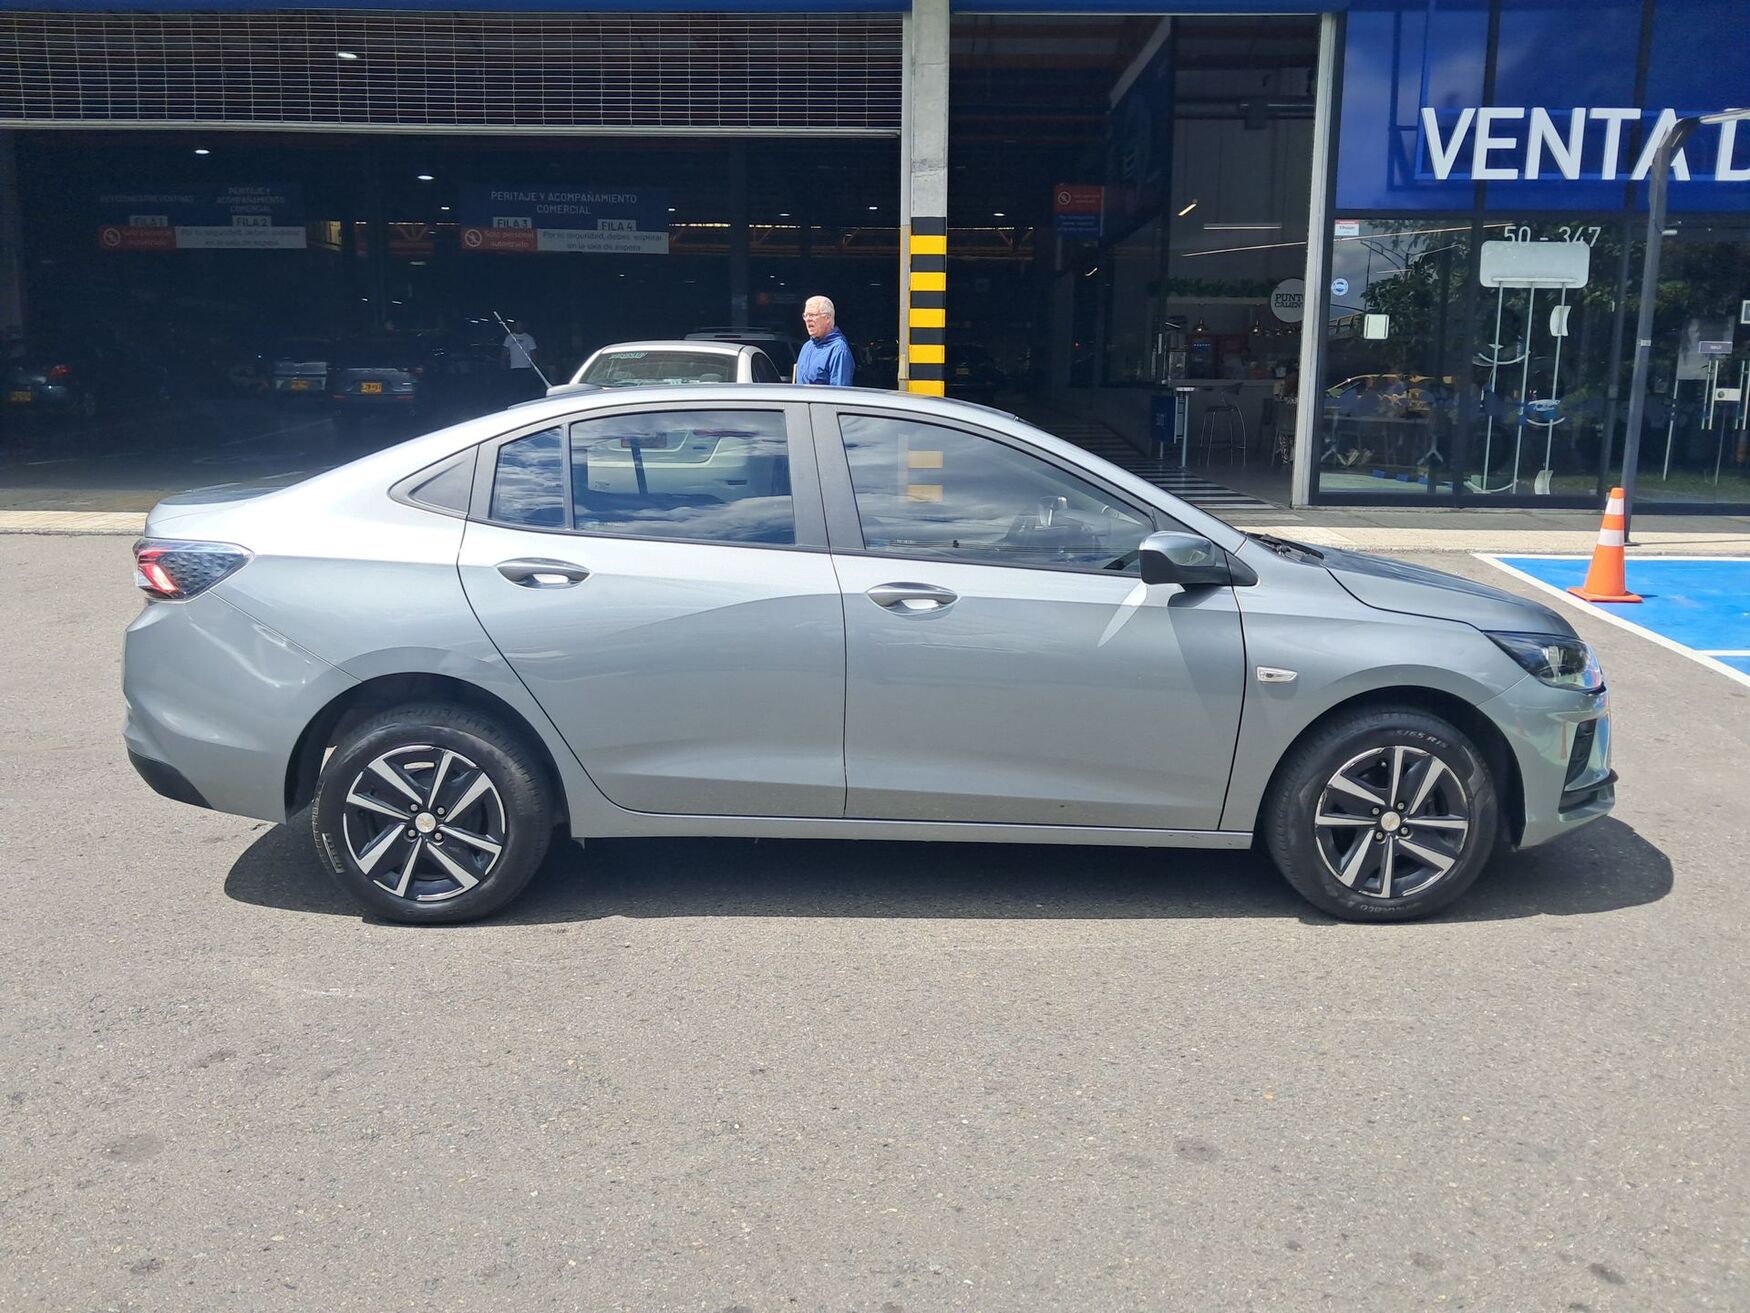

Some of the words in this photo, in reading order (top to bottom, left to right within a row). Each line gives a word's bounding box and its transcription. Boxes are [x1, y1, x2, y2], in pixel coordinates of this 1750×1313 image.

[1421, 107, 1690, 181] VENTA
[490, 190, 537, 202] PERITAJE
[539, 191, 545, 202] Y
[547, 190, 637, 204] ACOMPAÑAMIENTO
[536, 204, 592, 214] COMERCIAL
[236, 217, 259, 227] FILA
[261, 217, 268, 227] 2
[497, 218, 520, 229] FILA
[522, 219, 529, 229] 3
[601, 221, 624, 232] FILA
[625, 221, 633, 232] 4
[1504, 225, 1531, 243] 50
[1558, 226, 1602, 247] 347
[1275, 293, 1304, 301] PUNT
